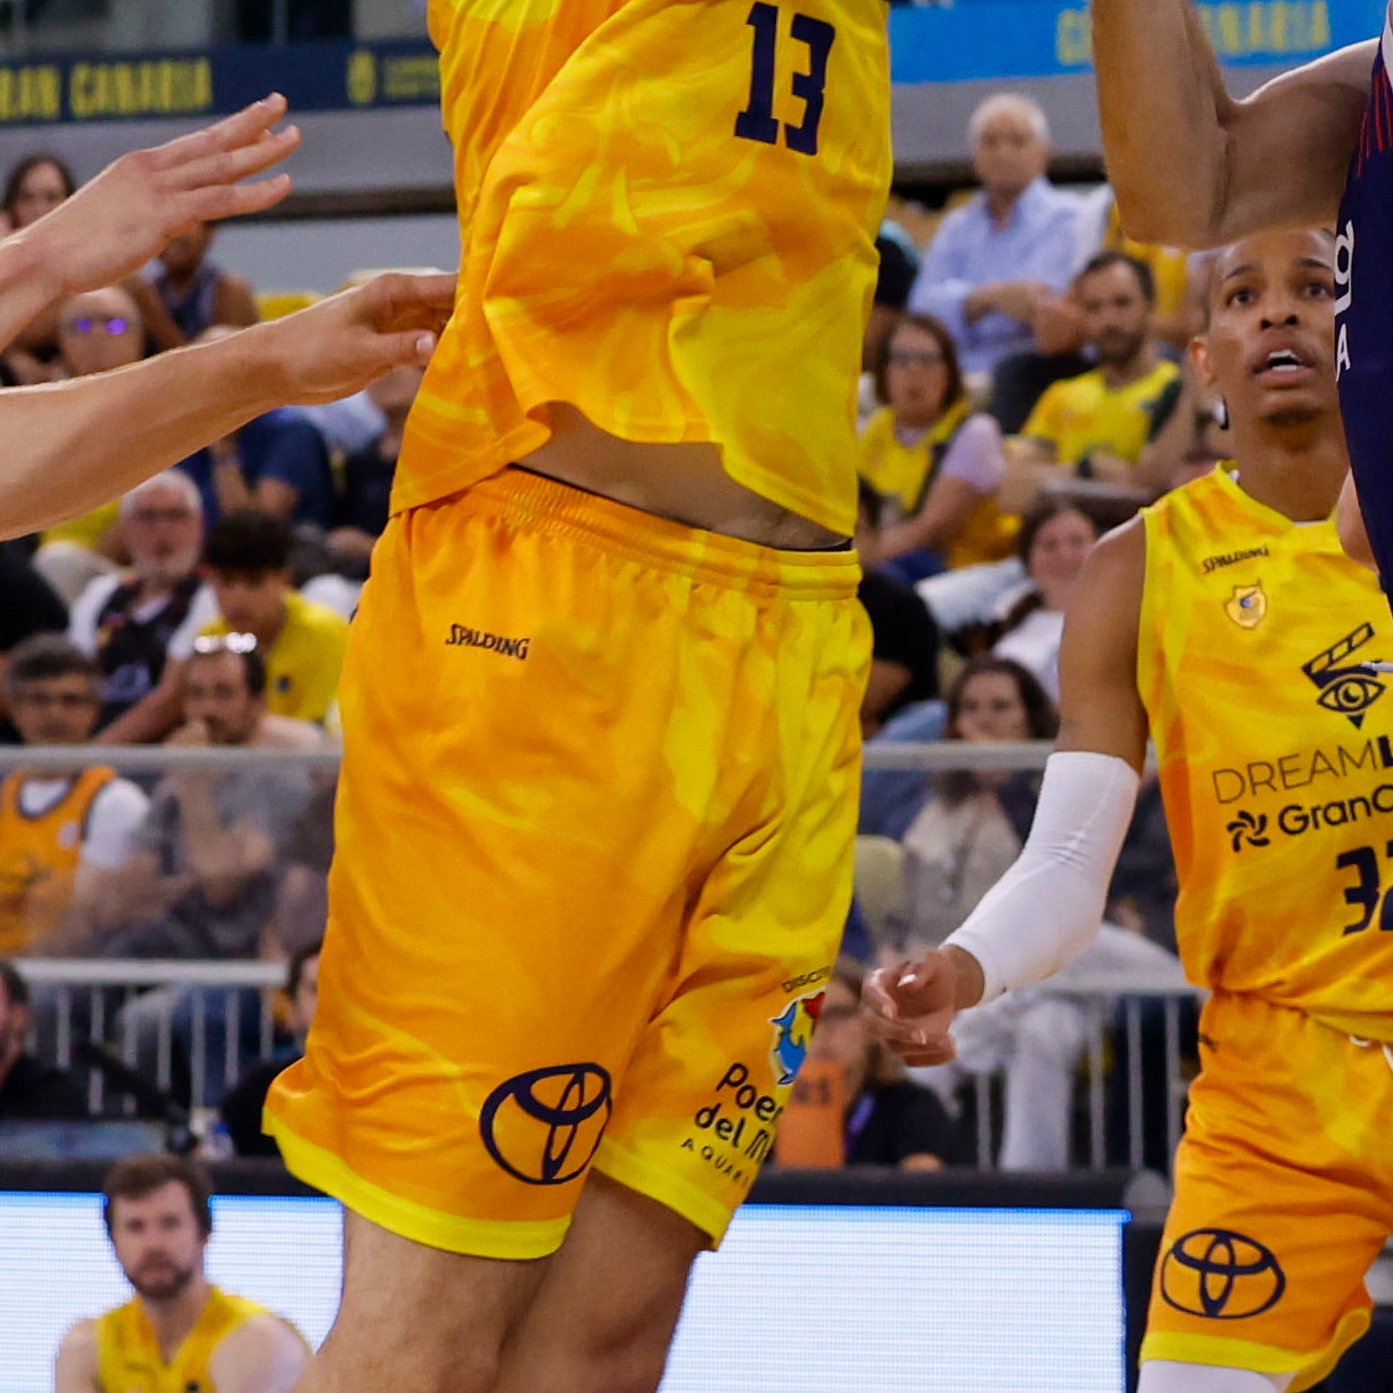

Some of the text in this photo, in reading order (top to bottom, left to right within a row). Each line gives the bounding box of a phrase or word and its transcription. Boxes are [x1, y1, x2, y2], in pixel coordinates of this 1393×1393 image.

[734, 1, 836, 156] 13
[445, 622, 530, 661] SPALDING
[716, 1062, 785, 1125] Poe
[695, 1102, 746, 1148] del
